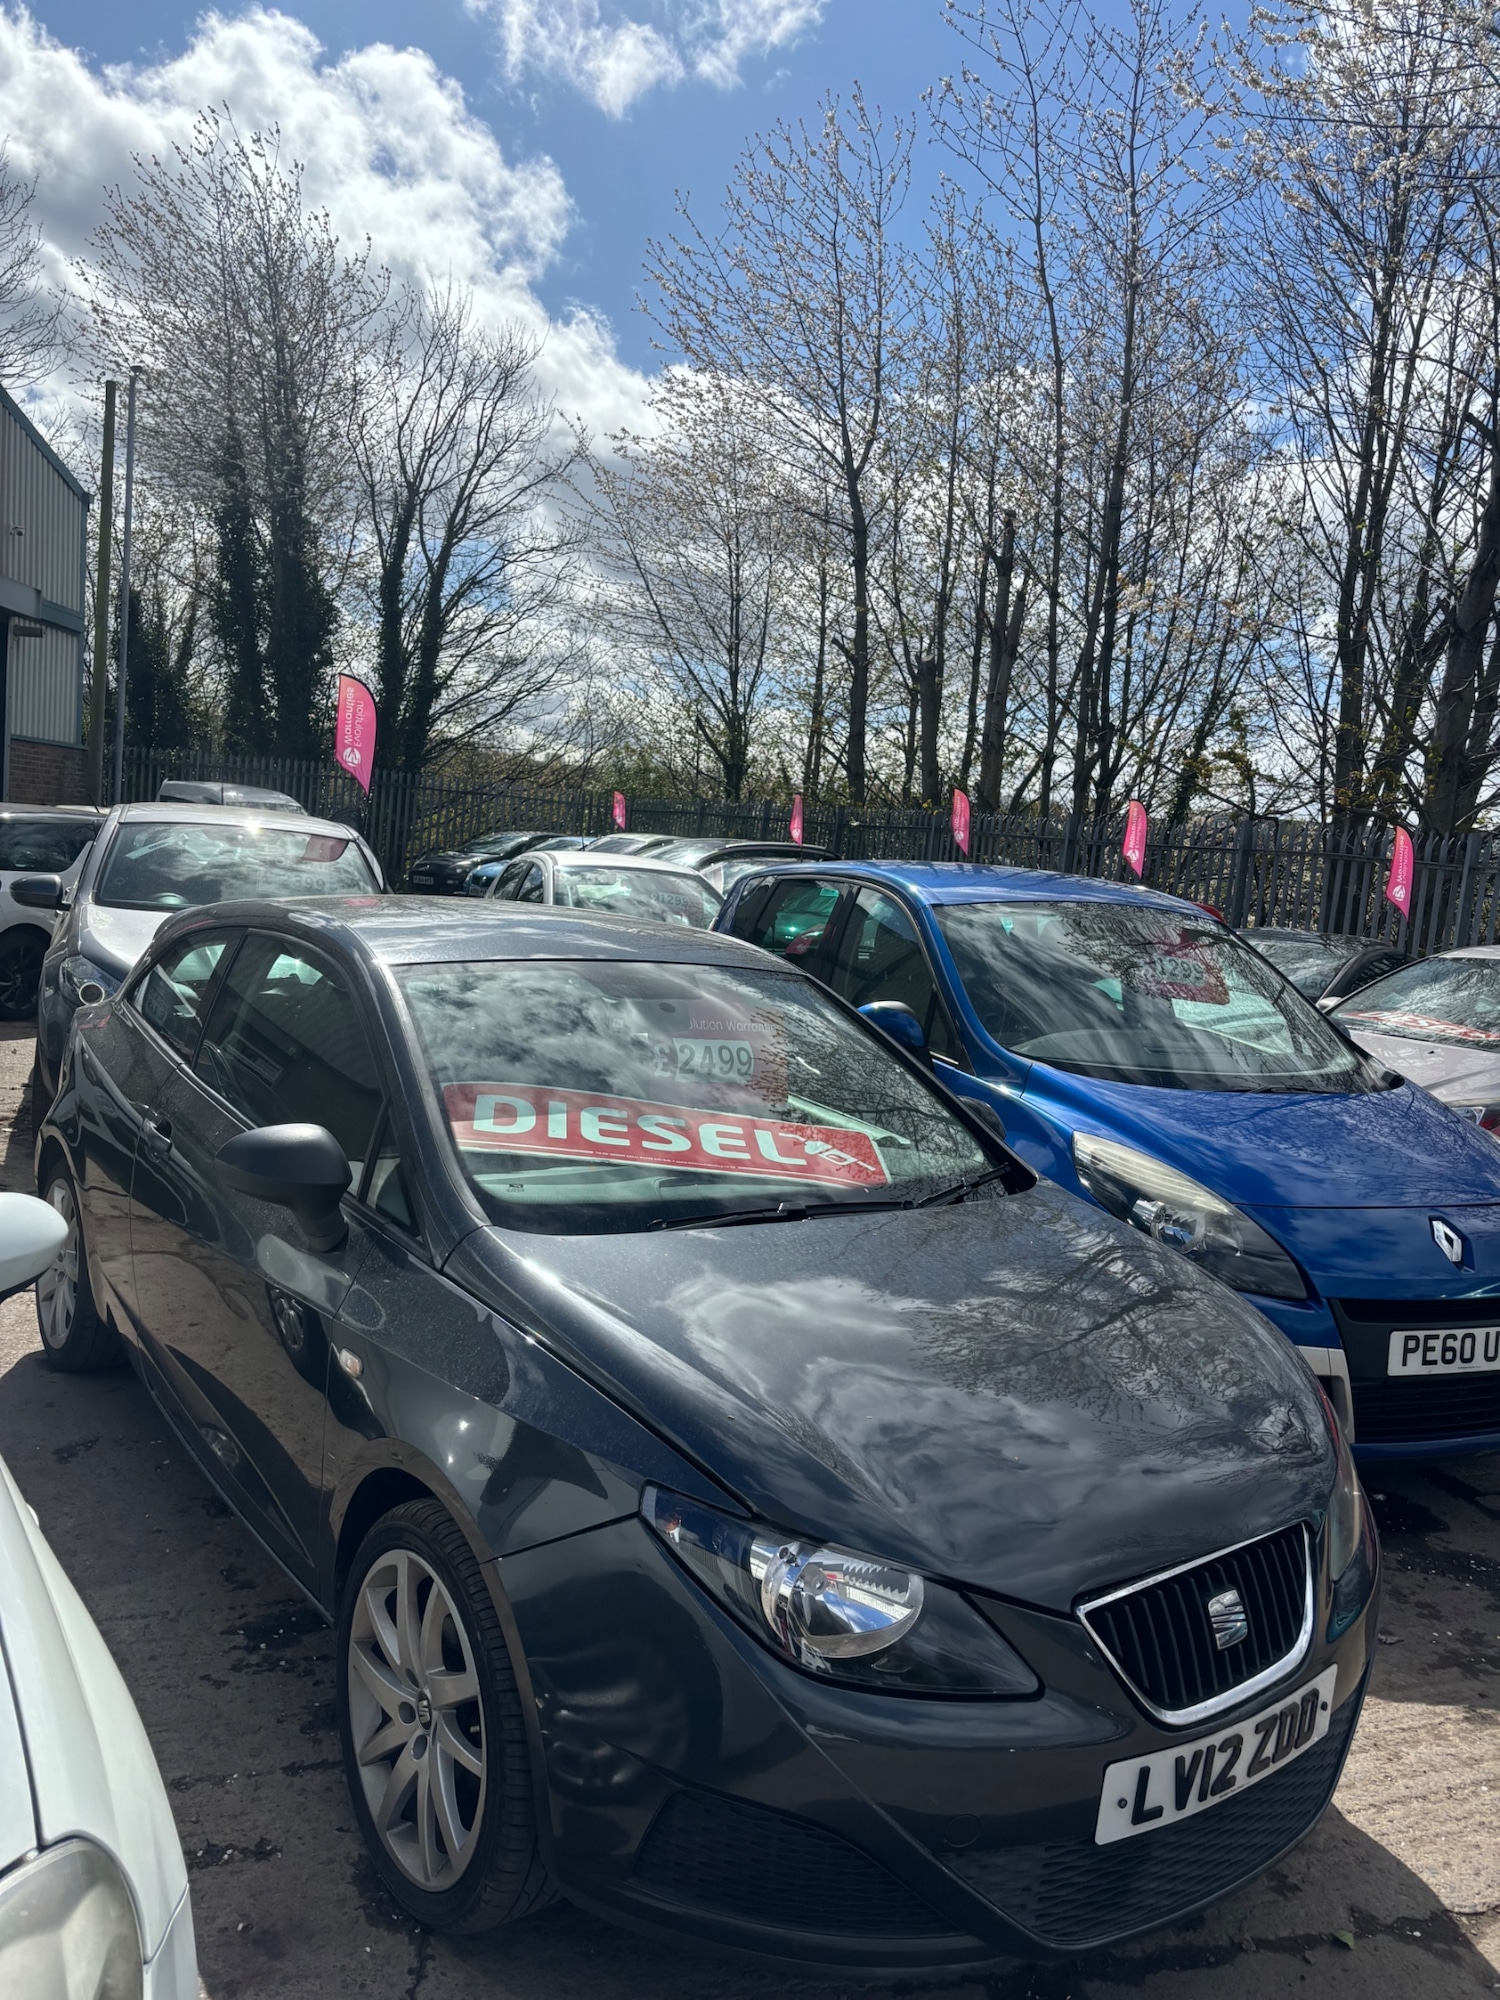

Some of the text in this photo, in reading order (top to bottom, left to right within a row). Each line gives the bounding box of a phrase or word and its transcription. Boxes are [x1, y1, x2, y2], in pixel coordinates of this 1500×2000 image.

[473, 1094, 807, 1165] DIESEL
[1402, 1333, 1476, 1367] PE60
[1131, 1688, 1319, 1826] LV12 ZDD
